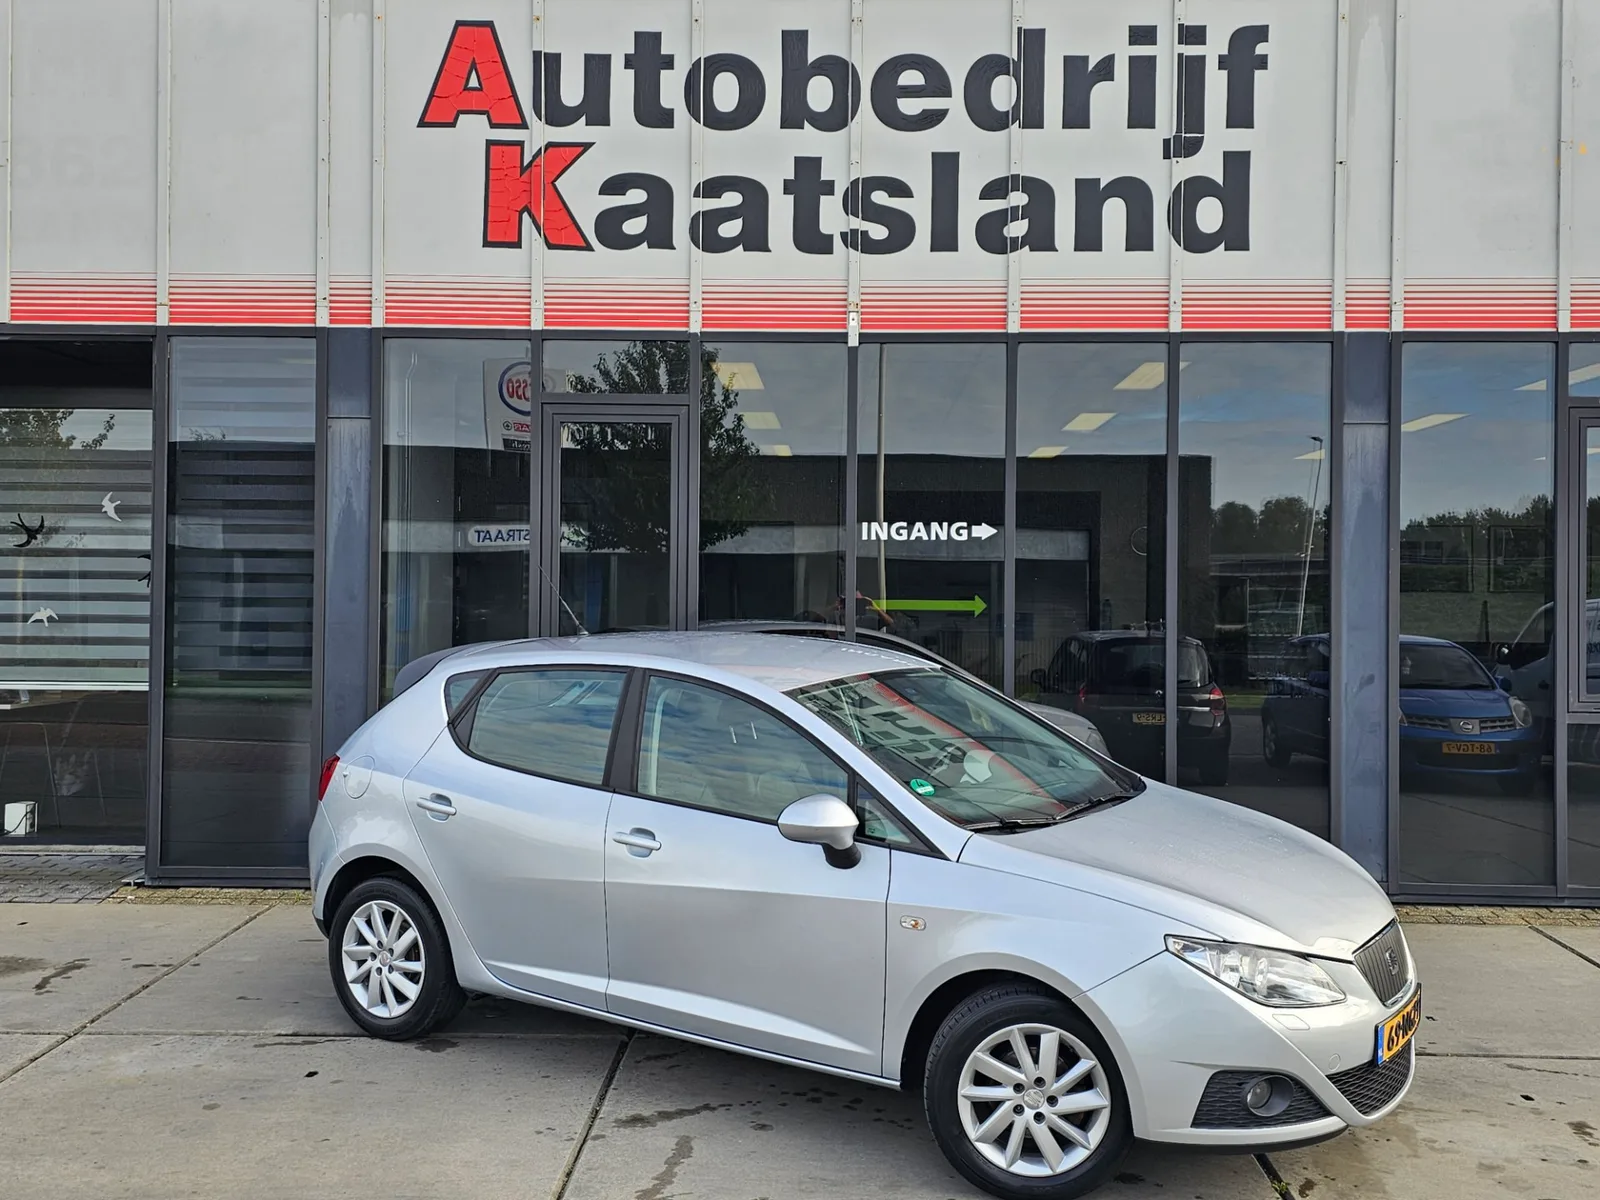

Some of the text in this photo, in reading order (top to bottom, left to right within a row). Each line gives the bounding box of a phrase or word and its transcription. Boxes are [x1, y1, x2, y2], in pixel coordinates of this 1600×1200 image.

[417, 20, 1269, 159] Autobedrijf
[483, 139, 1252, 255] Kaatsland
[861, 521, 969, 541] INGANG
